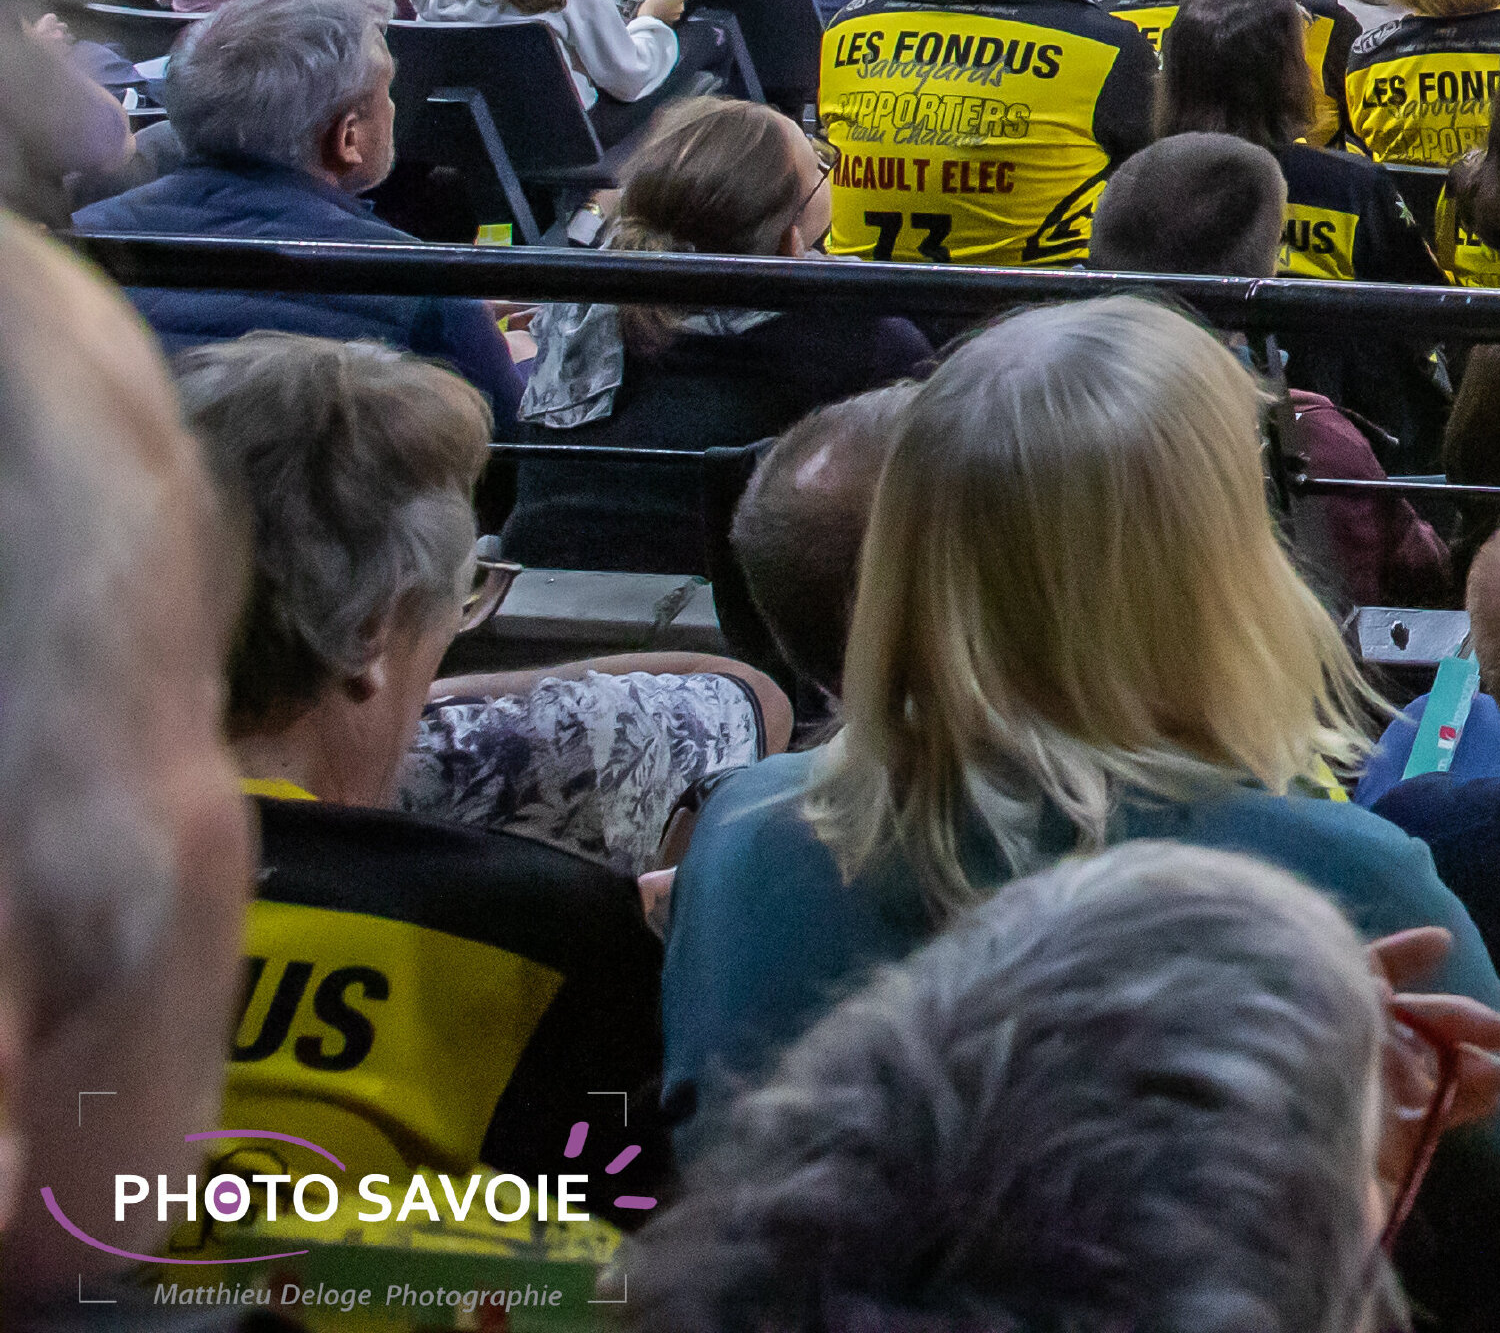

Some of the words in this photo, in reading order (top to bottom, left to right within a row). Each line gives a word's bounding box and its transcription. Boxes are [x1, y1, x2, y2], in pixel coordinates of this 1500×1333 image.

[834, 31, 885, 69] LES
[895, 31, 1063, 80] FONDUS
[1363, 75, 1406, 109] LES
[838, 90, 1031, 139] SUPPORTERS
[942, 159, 1015, 194] ELEC
